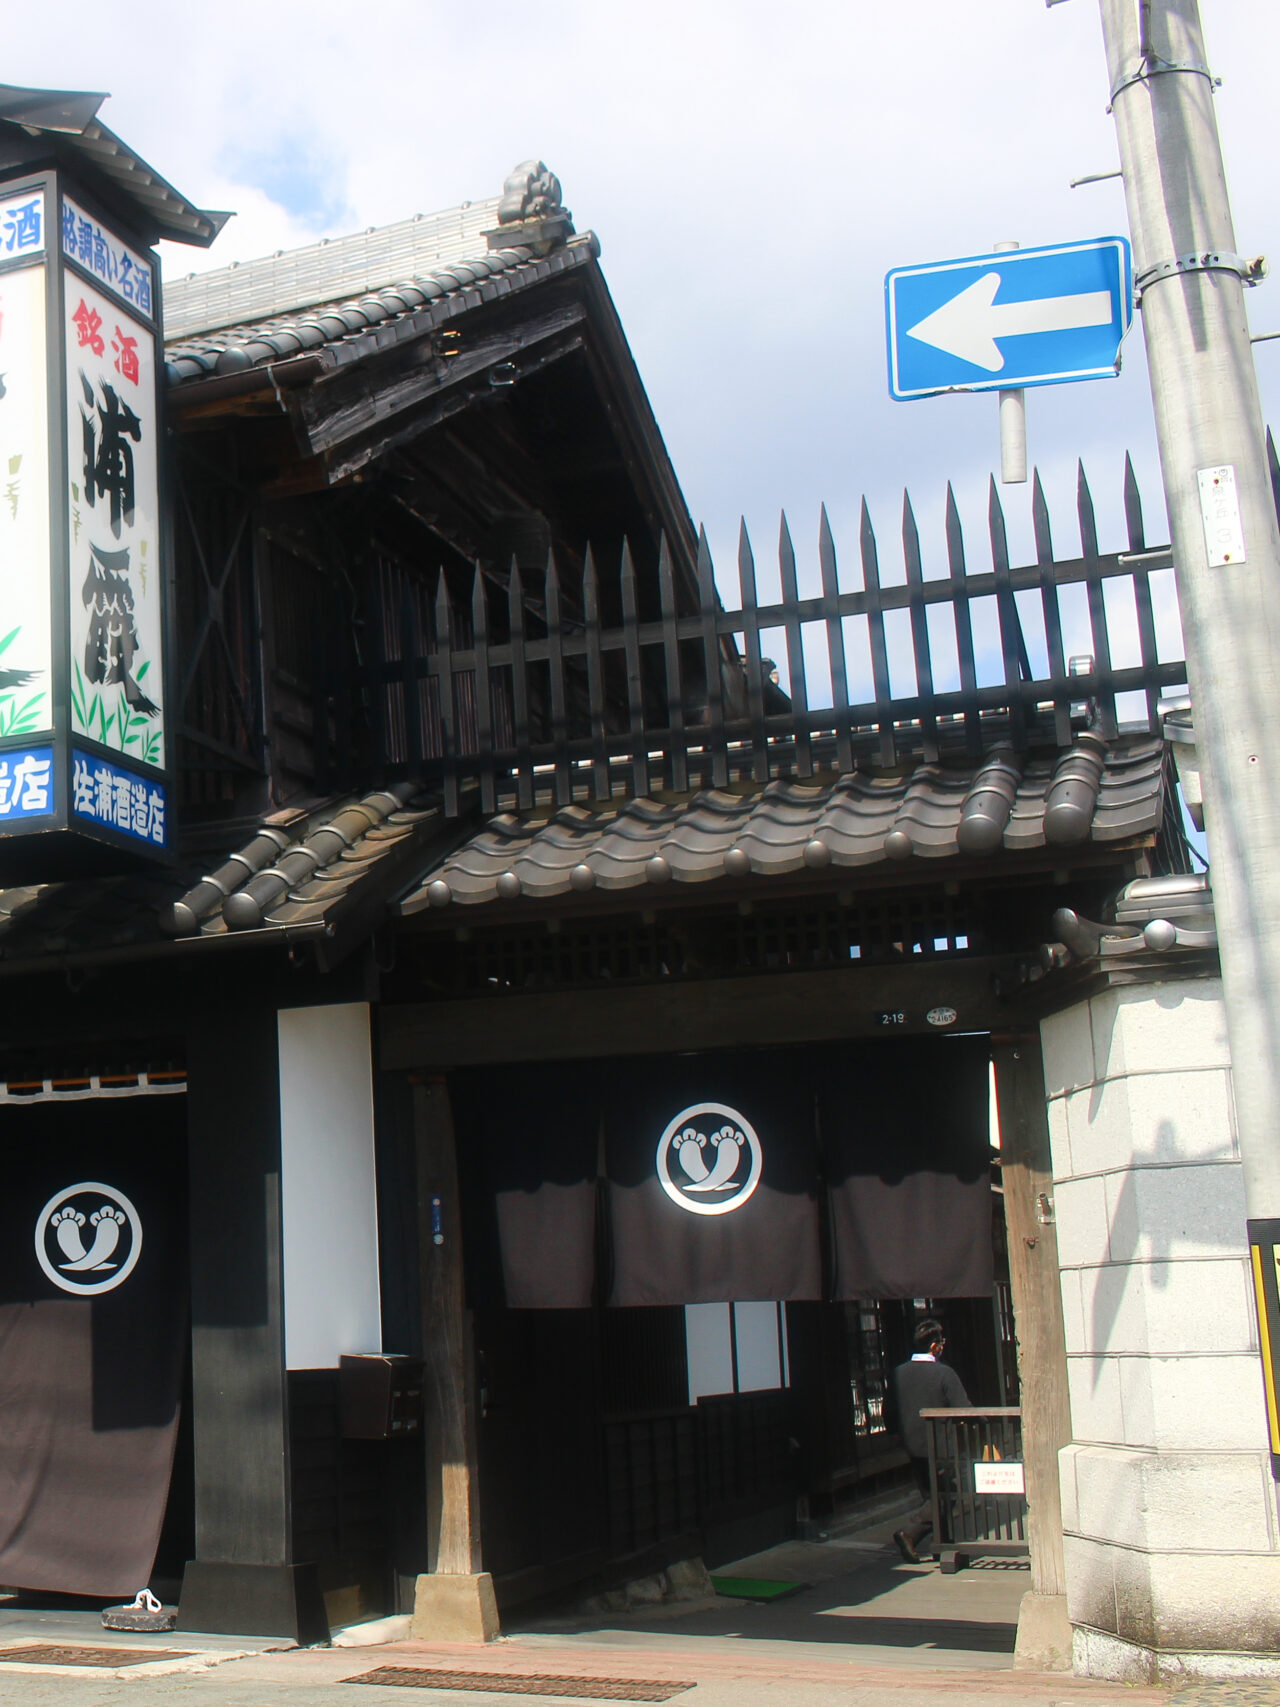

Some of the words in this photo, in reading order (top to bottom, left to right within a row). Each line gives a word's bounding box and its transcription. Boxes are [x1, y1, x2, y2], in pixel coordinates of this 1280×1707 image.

[62, 203, 151, 314] 格調高い名酒
[71, 298, 139, 386] 銘酒
[77, 367, 162, 718] 浦霞
[73, 760, 166, 844] 佐浦酒造店
